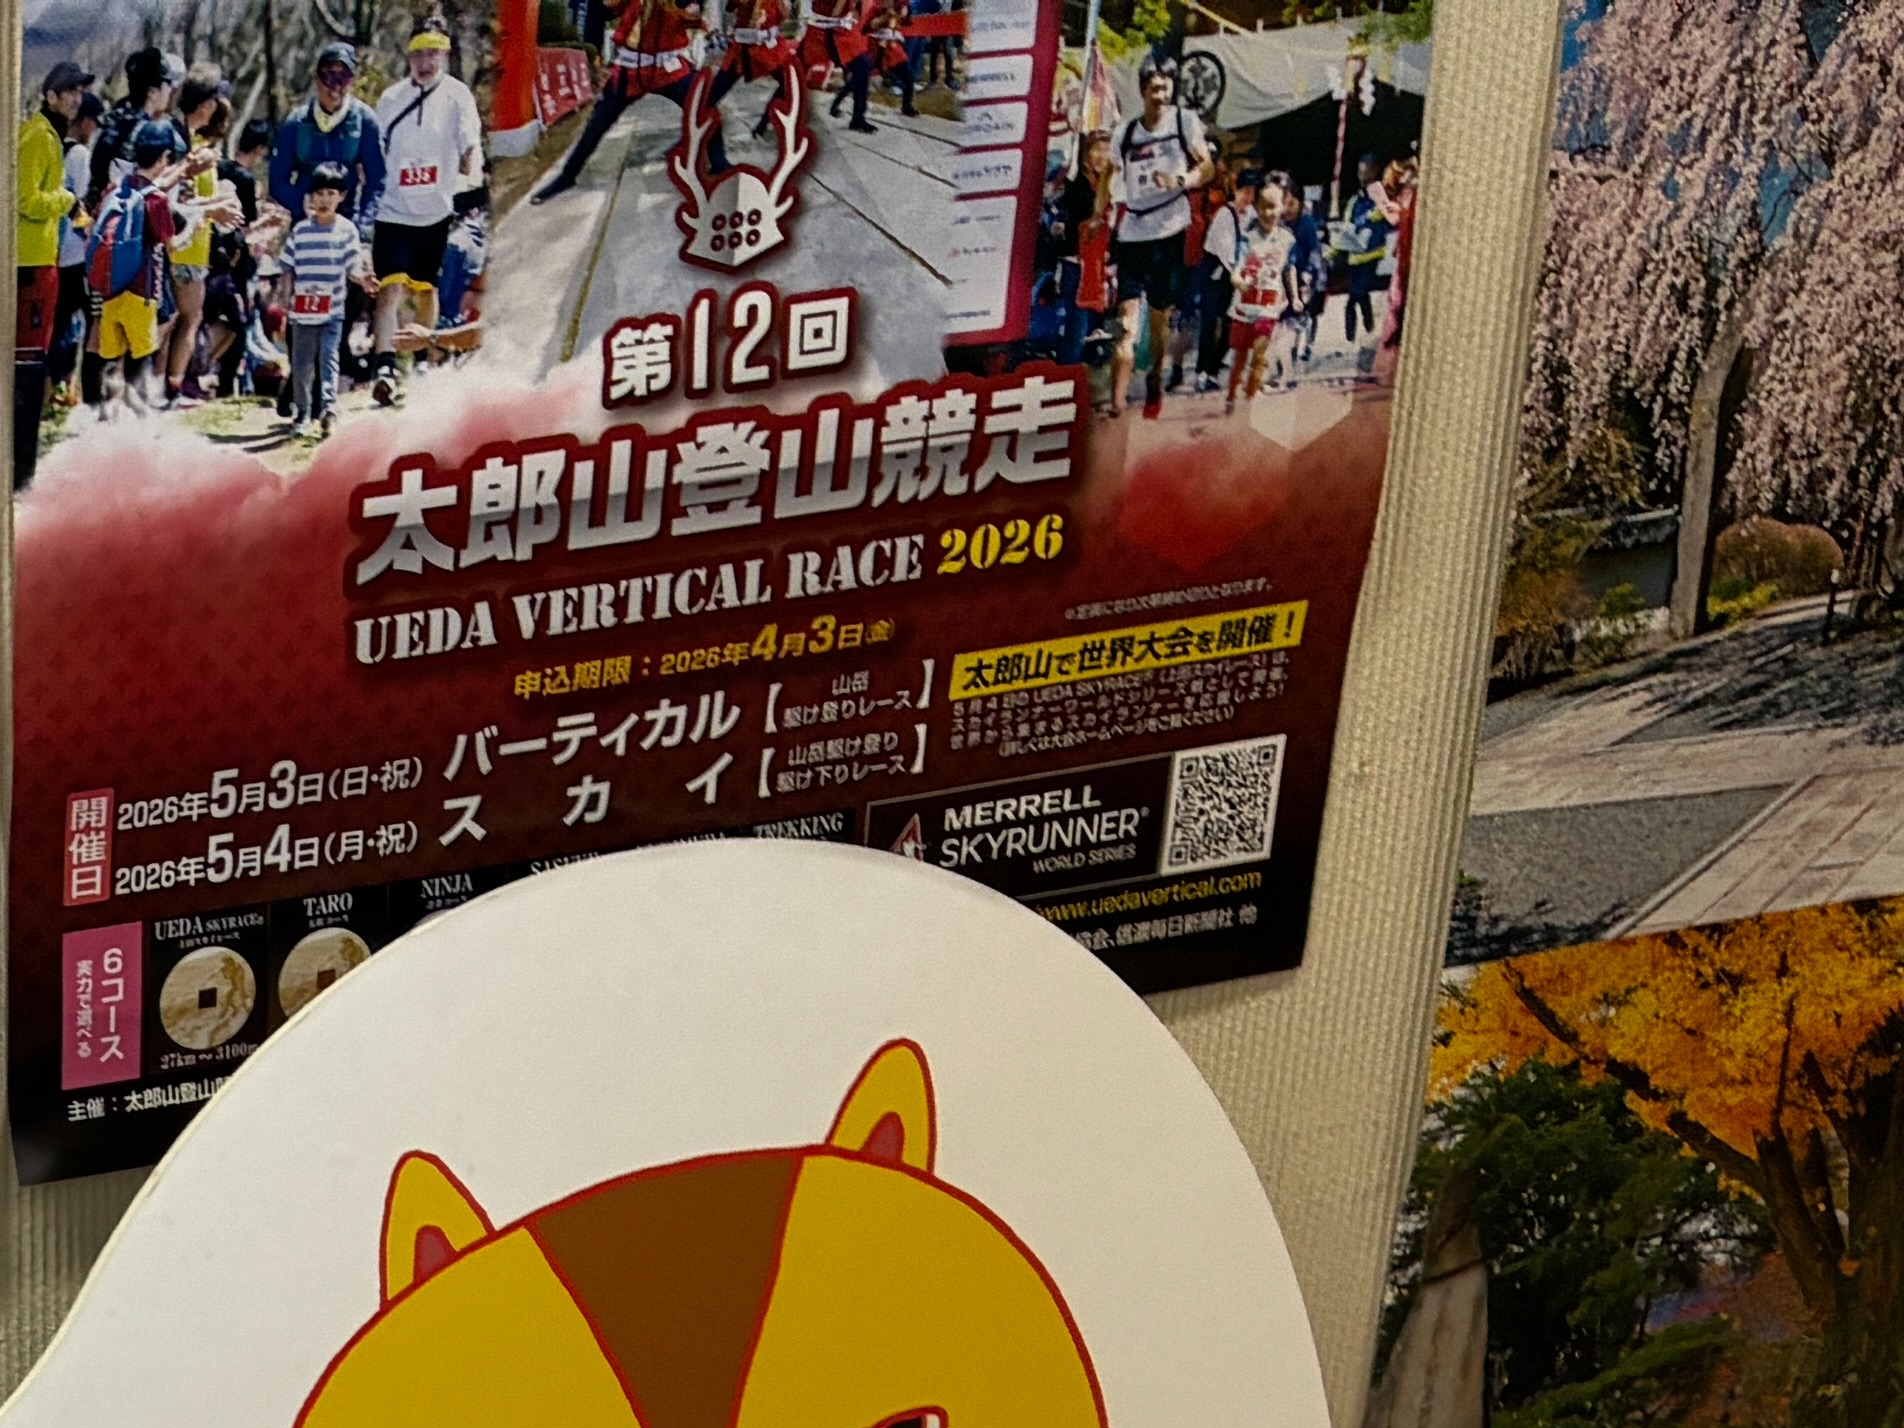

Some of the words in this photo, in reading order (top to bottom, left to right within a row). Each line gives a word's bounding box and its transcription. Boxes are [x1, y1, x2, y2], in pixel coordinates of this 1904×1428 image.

[608, 290, 852, 401] 第12回
[355, 376, 1080, 586] 太郎山登山競走
[354, 602, 496, 664] UEDA
[511, 551, 772, 641] VERTICAL
[786, 534, 924, 600] RACE
[935, 513, 1066, 577] 2026
[442, 690, 742, 782] バーティカル
[68, 795, 108, 900] 開催日
[943, 785, 1102, 832] MERRELL
[154, 916, 204, 941] UEDA
[302, 892, 354, 918] TARO
[420, 872, 474, 899] NINJA
[99, 948, 125, 1062] 6コース
